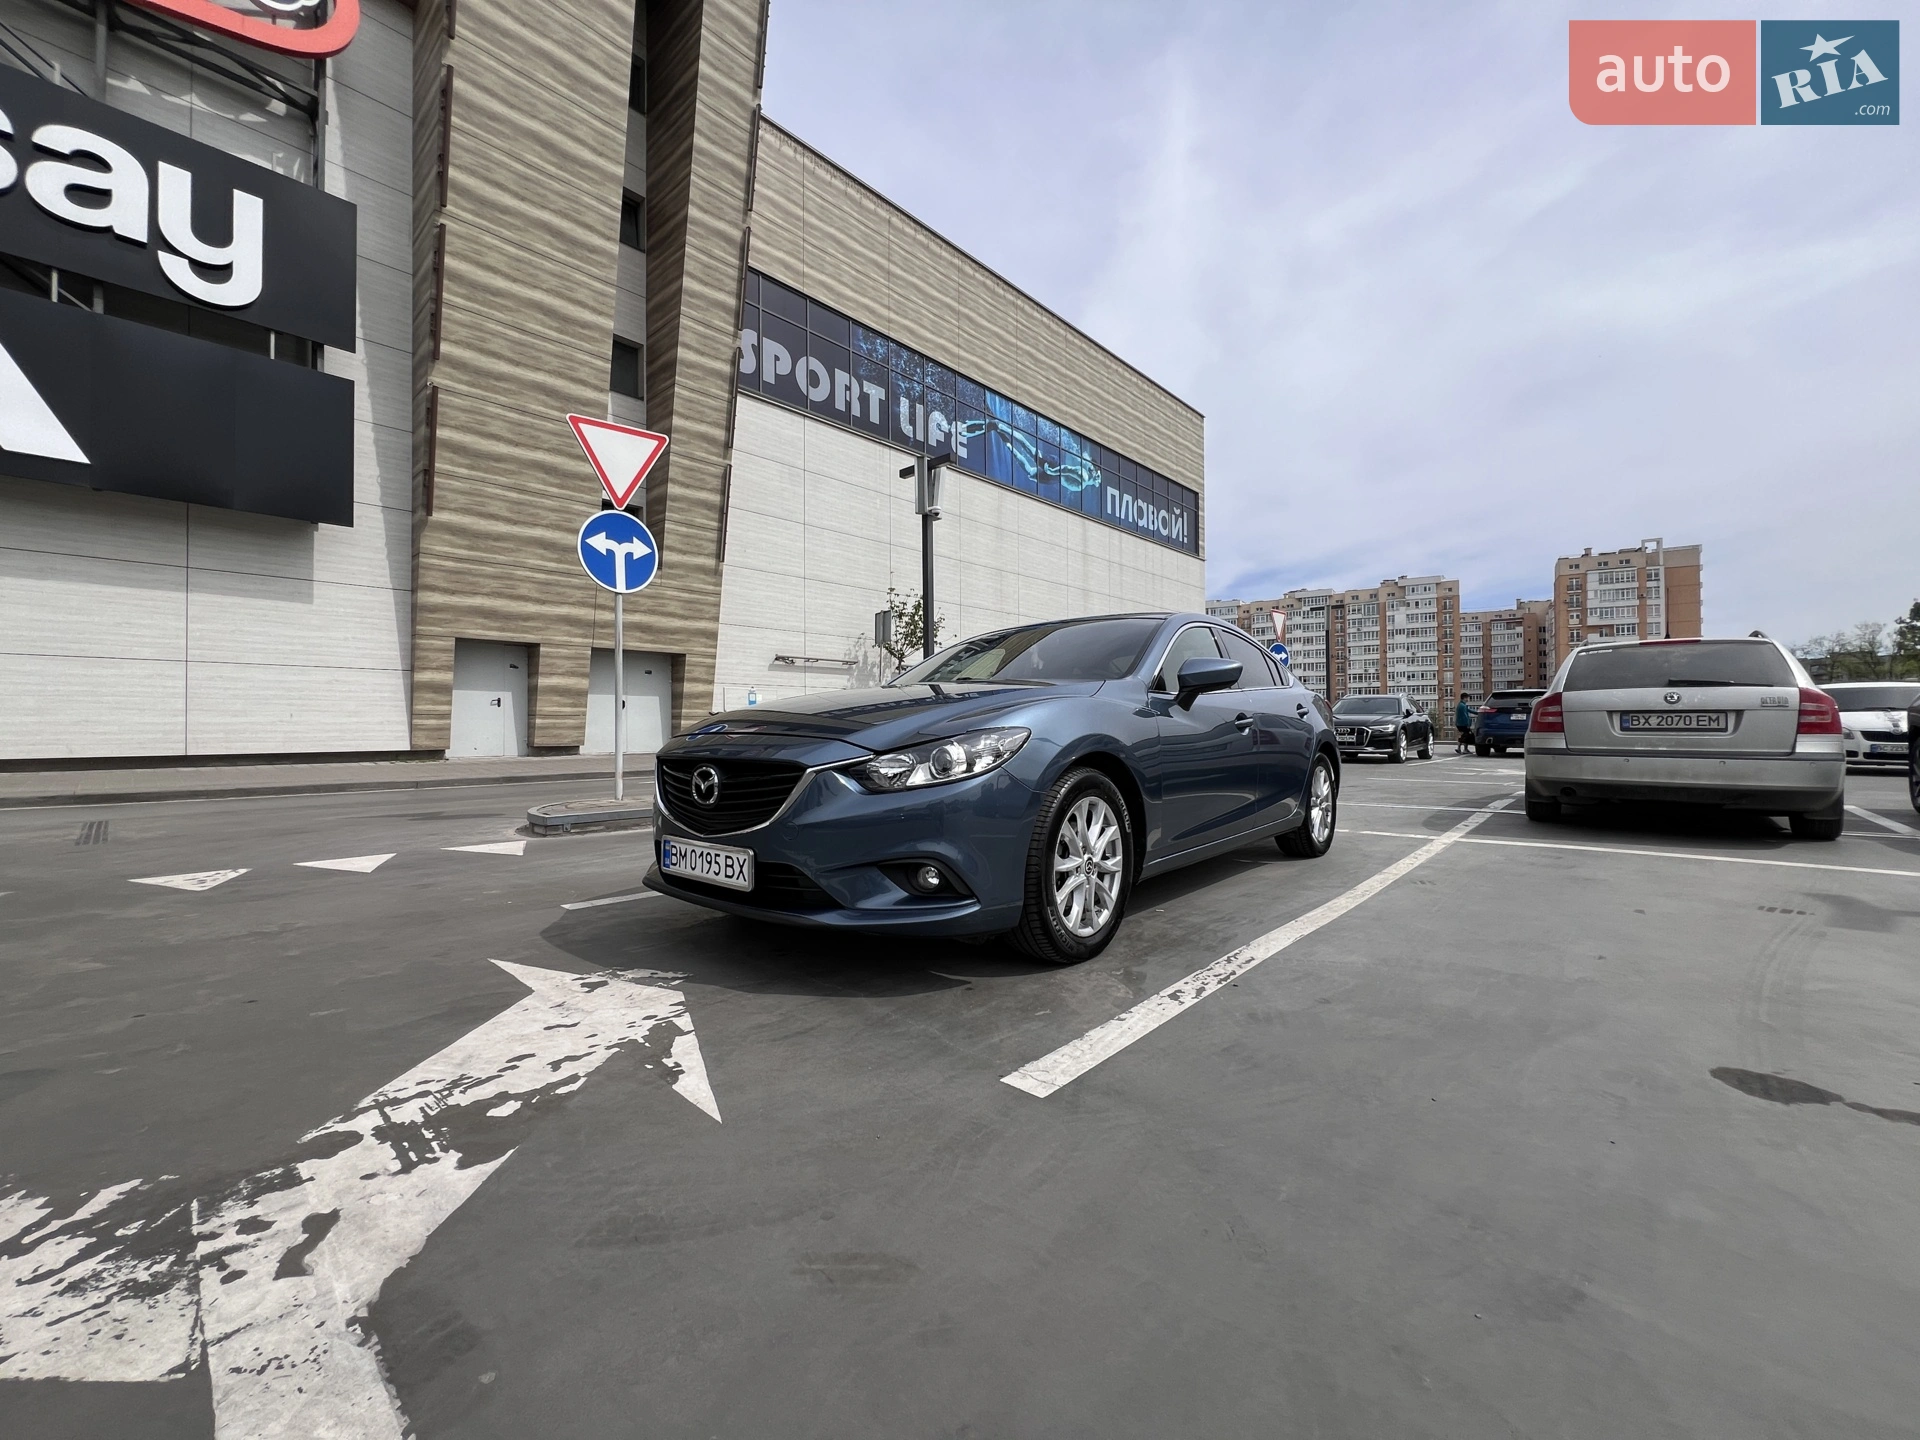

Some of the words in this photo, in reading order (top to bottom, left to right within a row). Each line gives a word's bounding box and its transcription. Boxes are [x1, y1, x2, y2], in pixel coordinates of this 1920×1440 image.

[739, 328, 886, 425] SPORT
[1630, 715, 1652, 727] BX
[1656, 715, 1692, 727] 2070
[1696, 715, 1720, 727] EM
